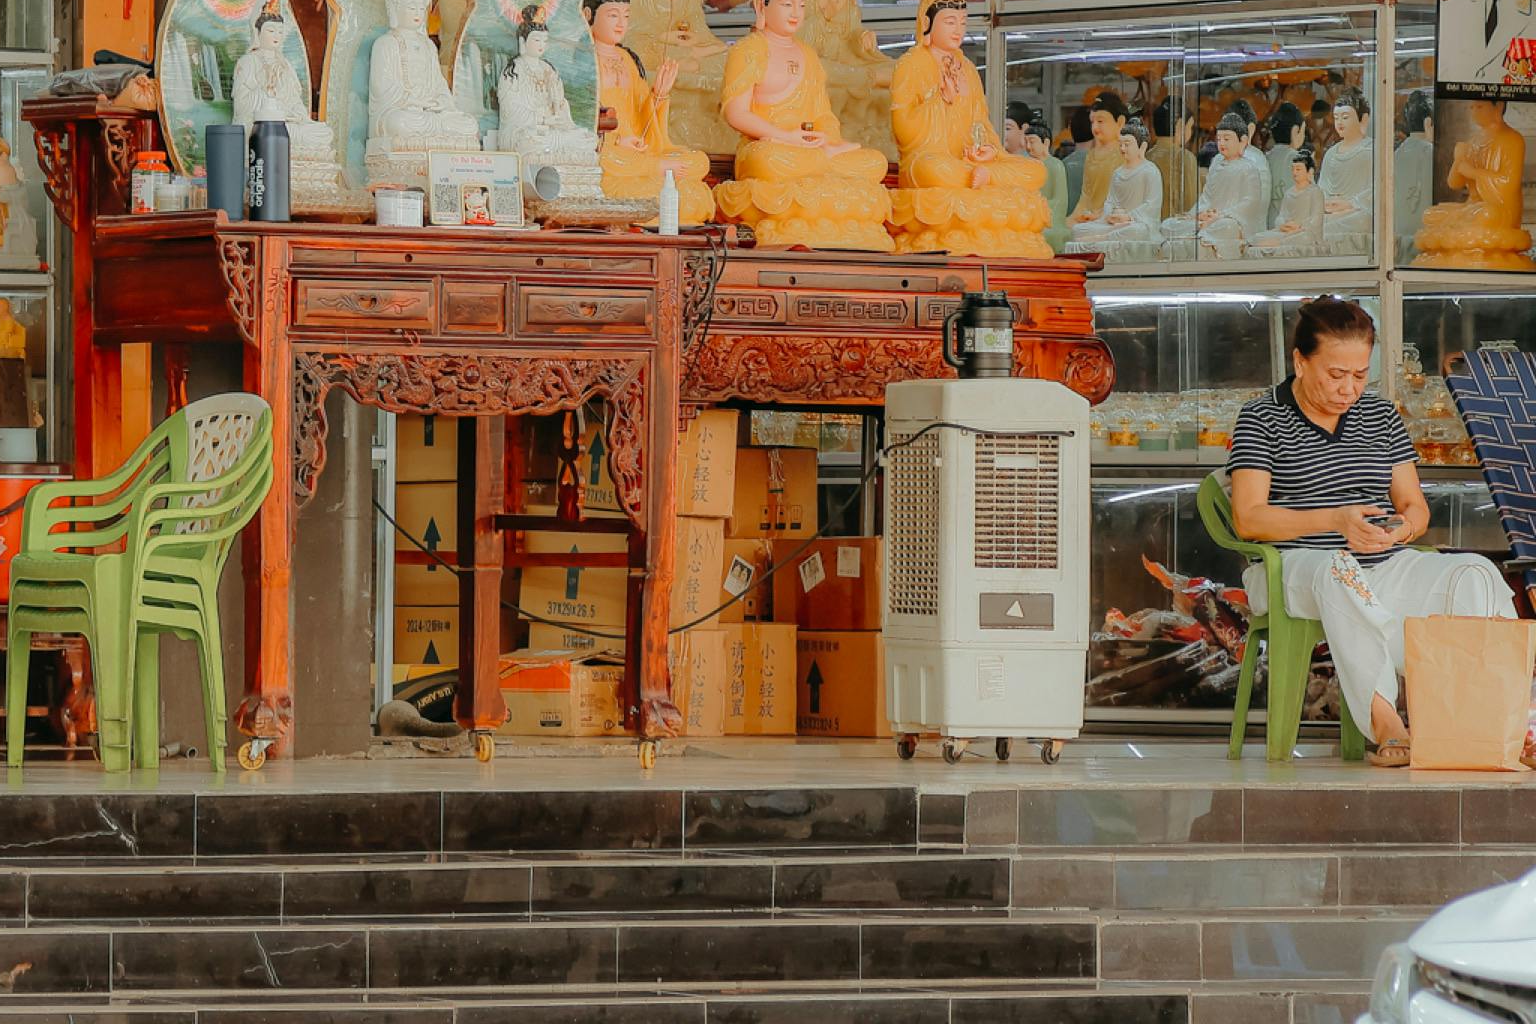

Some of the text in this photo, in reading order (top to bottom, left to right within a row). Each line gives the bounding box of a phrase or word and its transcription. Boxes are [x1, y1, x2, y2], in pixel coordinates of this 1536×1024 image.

[255, 158, 266, 207] originals
[691, 426, 713, 503] 小心轻放
[684, 538, 704, 615] 小心轻放
[688, 647, 707, 728] 小心轻放
[729, 639, 747, 718] 请勿倒置
[757, 642, 776, 718] 小心轻放
